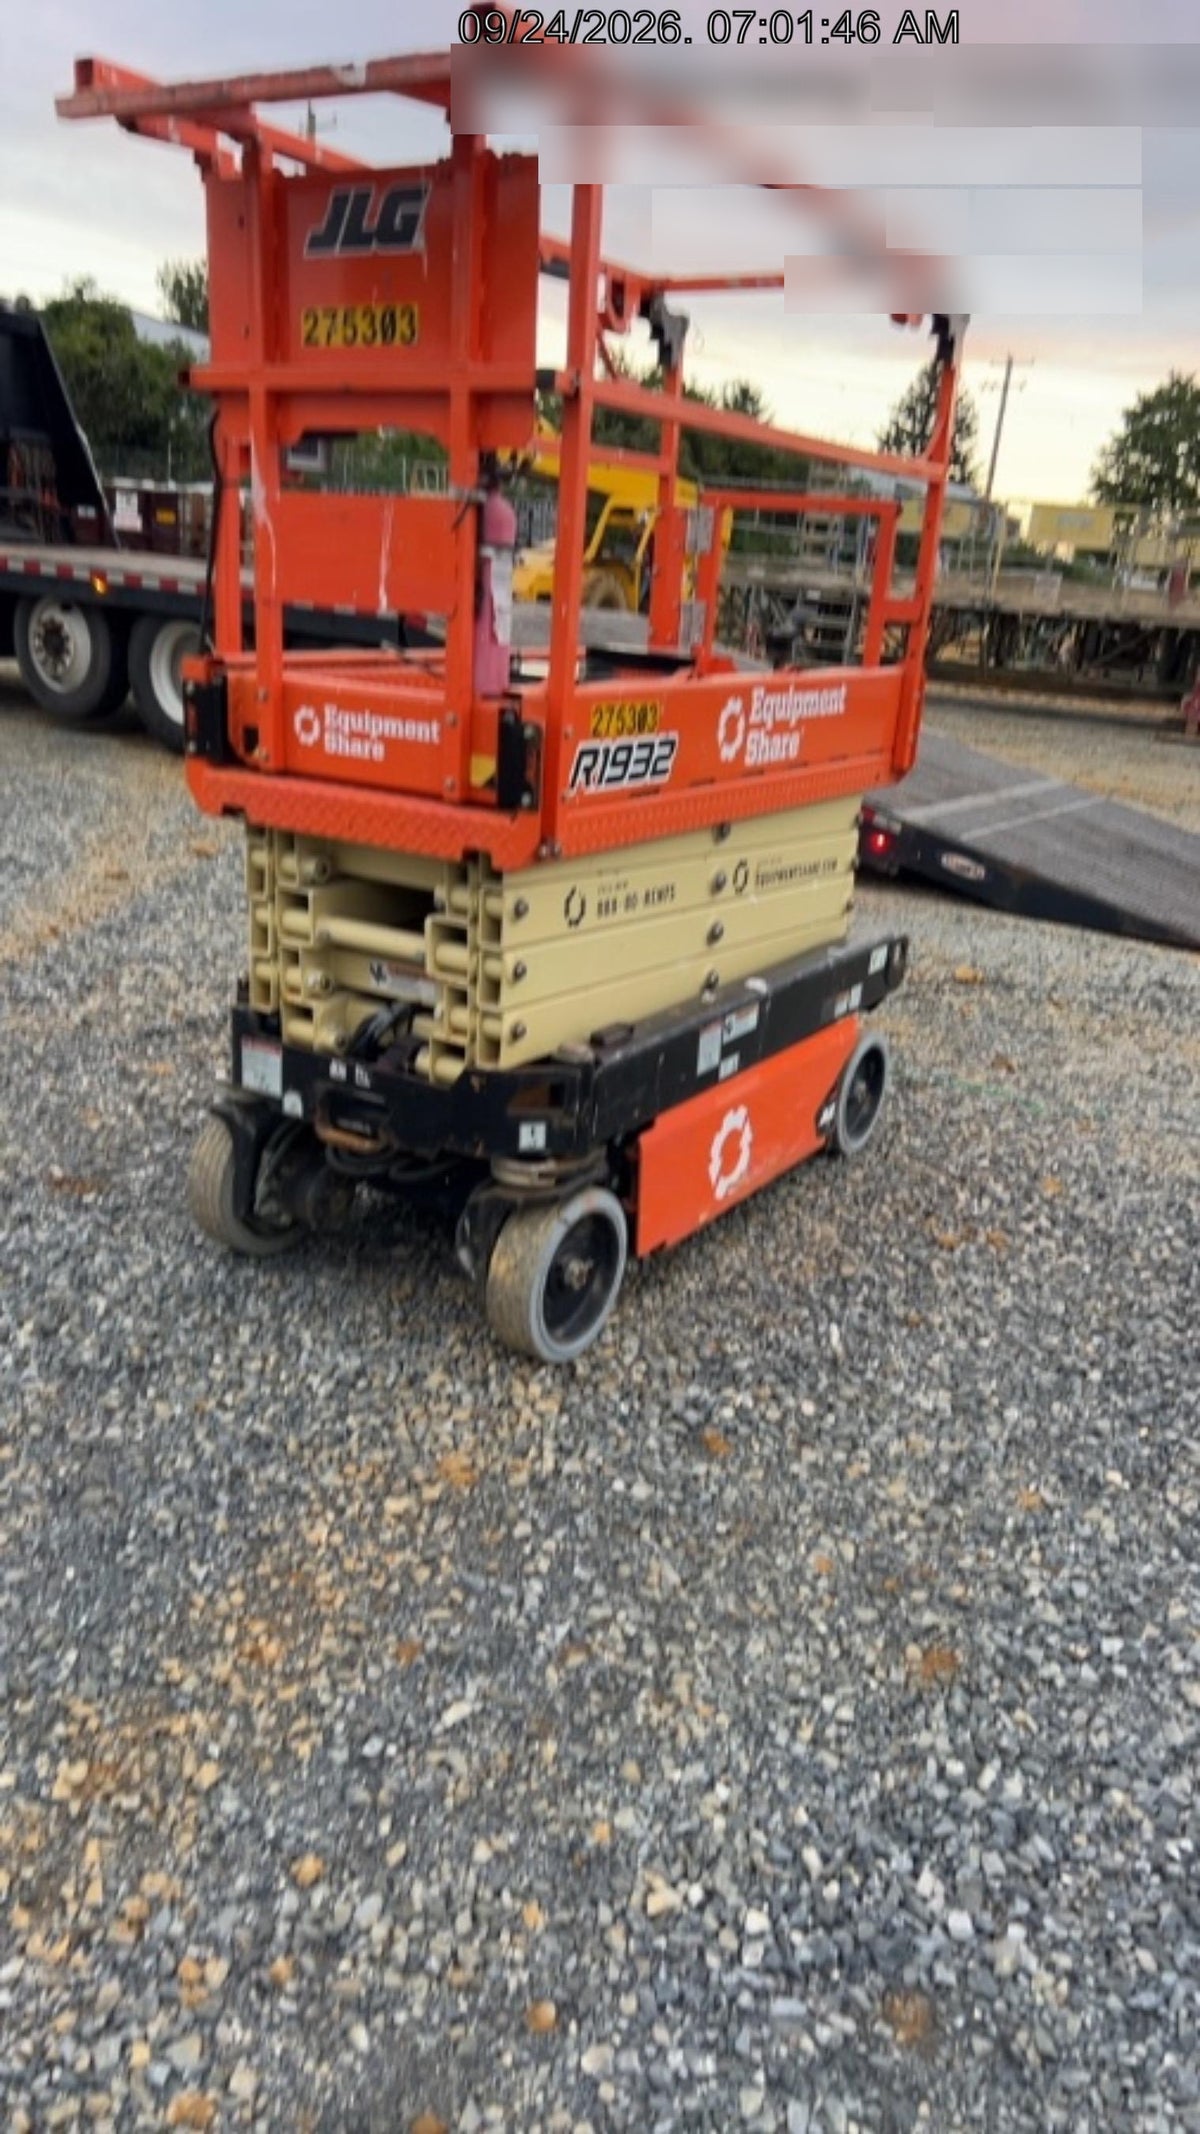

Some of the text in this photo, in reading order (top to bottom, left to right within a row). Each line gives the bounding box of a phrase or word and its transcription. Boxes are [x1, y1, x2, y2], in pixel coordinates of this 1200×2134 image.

[303, 179, 432, 259] JLG
[303, 305, 417, 347] 275303
[324, 702, 441, 745] Equipment
[591, 703, 660, 738] 275303
[750, 684, 847, 730] Equipment
[569, 735, 677, 793] R1932
[744, 728, 801, 767] Share
